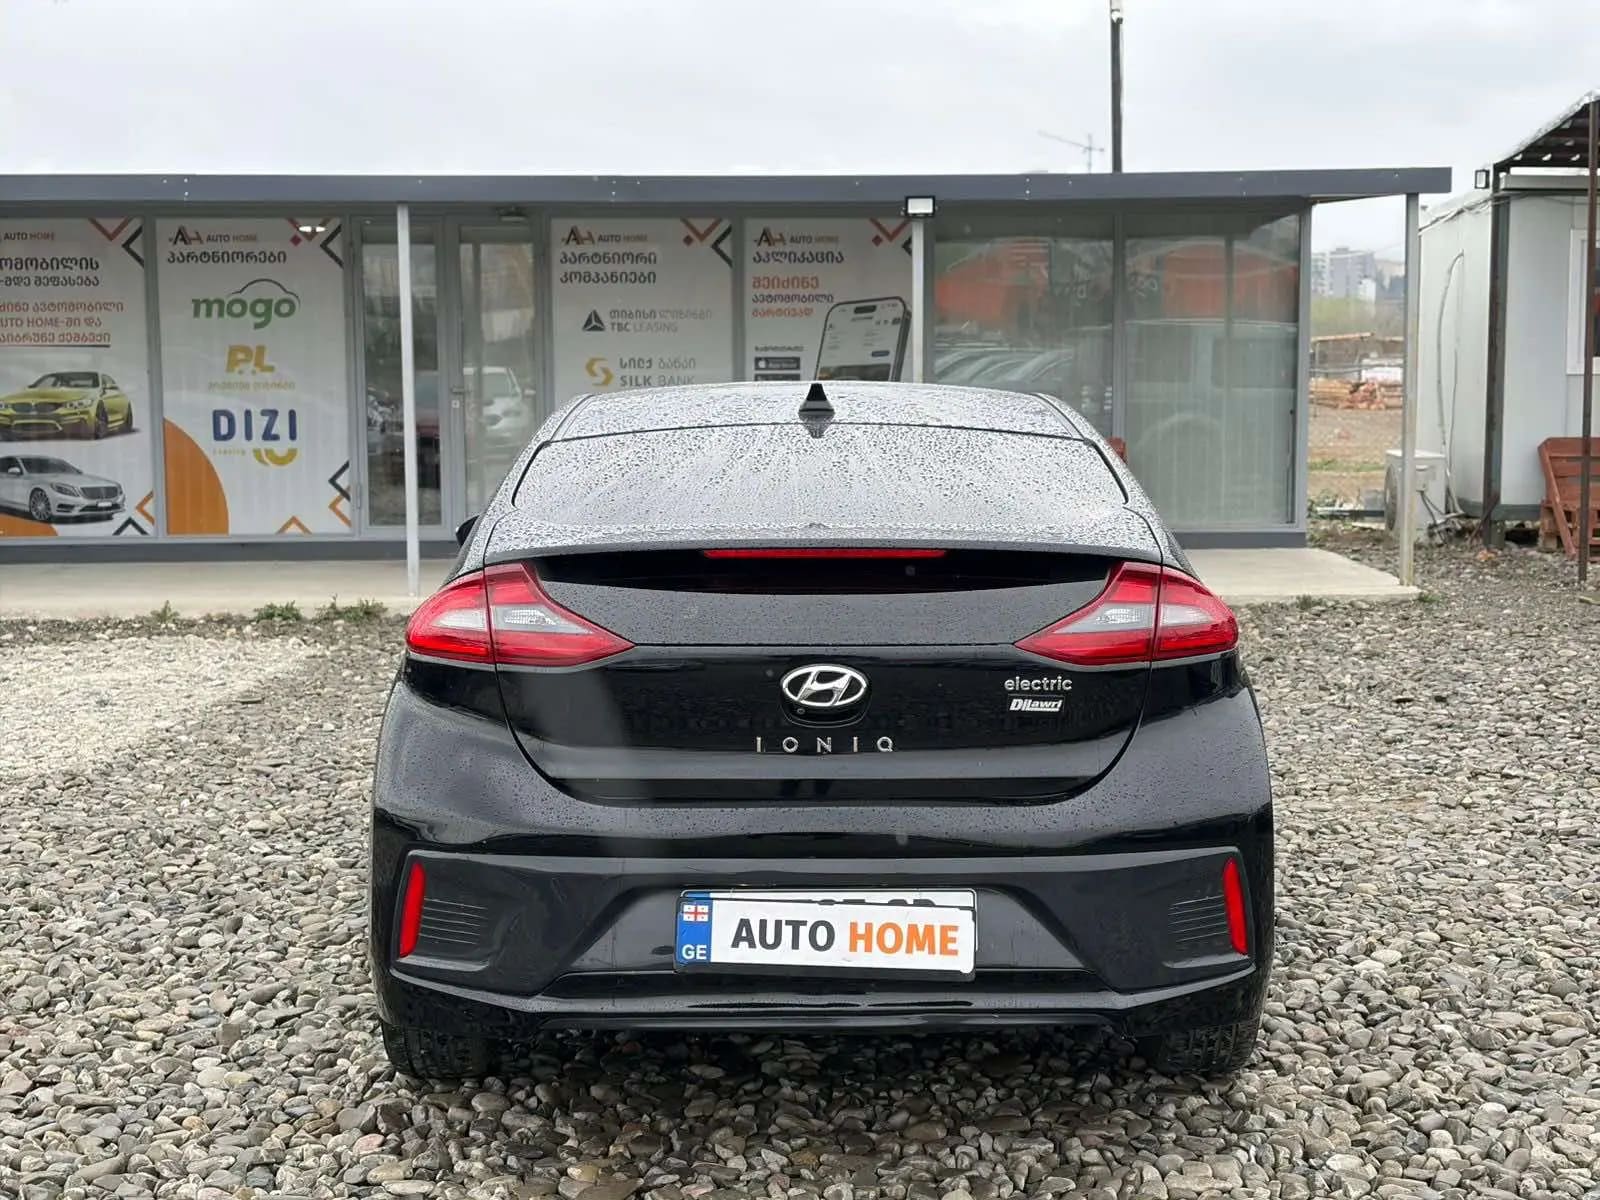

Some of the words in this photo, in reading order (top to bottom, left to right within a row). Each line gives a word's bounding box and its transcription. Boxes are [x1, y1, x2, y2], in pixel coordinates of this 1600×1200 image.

[4, 232, 28, 241] AUTO
[206, 234, 231, 242] AUTO
[598, 234, 621, 242] AUTO
[790, 235, 813, 244] AUTO
[167, 251, 287, 264] პარტნიორები
[560, 251, 657, 265] პარტნიორი
[752, 251, 844, 264] აპლიკაცია
[34, 276, 100, 287] შეფასება
[560, 271, 657, 284] კომპანიები
[752, 275, 820, 289] შეიძინე
[752, 293, 834, 304] ავტომობილი
[32, 301, 124, 313] ავტომობილი
[192, 298, 296, 330] mogo
[609, 309, 656, 319] თიბისი
[84, 317, 102, 328] და
[611, 322, 631, 332] TBC
[633, 322, 678, 332] LEASING
[620, 376, 652, 386] SILK
[657, 375, 695, 386] BANK
[212, 409, 298, 441] DIZI
[1004, 676, 1073, 692] electric
[756, 737, 894, 753] IONIQ
[731, 918, 836, 951] AUTO
[849, 921, 959, 957] HOME
[681, 944, 708, 961] GE
